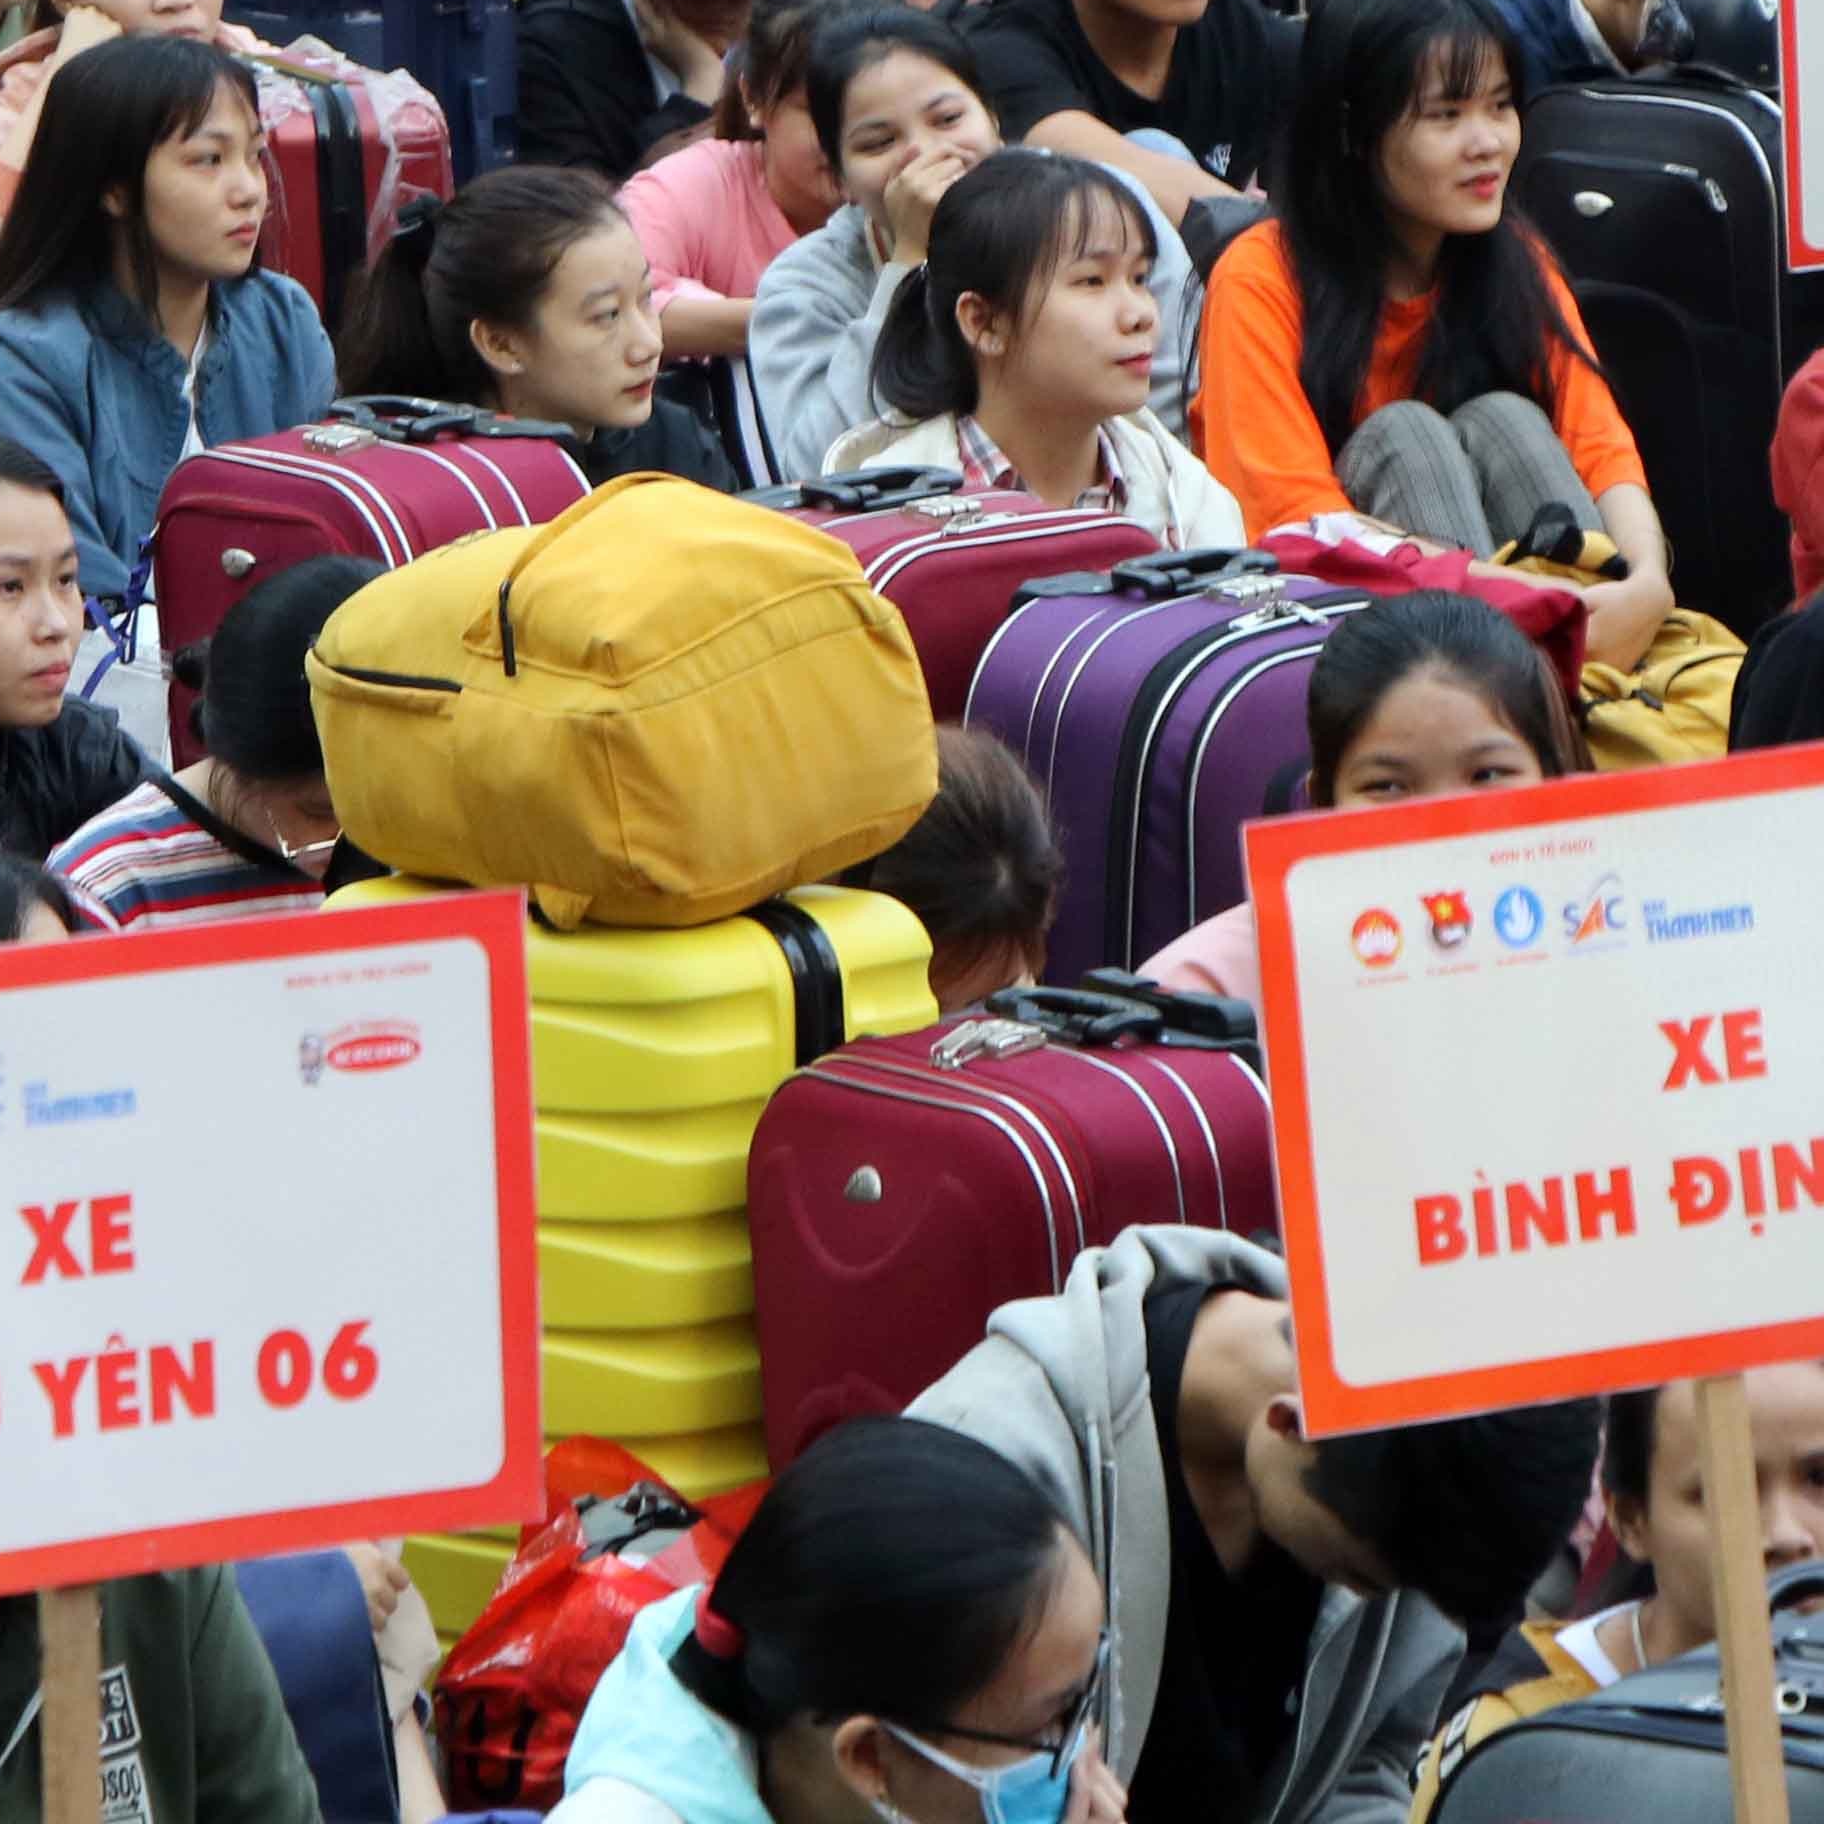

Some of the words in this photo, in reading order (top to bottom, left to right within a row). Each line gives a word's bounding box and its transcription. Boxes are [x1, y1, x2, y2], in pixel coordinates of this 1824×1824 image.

[1657, 1007, 1769, 1093] XE
[18, 1193, 135, 1287] XE
[1413, 1166, 1637, 1266] BÌNH
[31, 1332, 216, 1440] YÊN
[256, 1318, 380, 1410] 06
